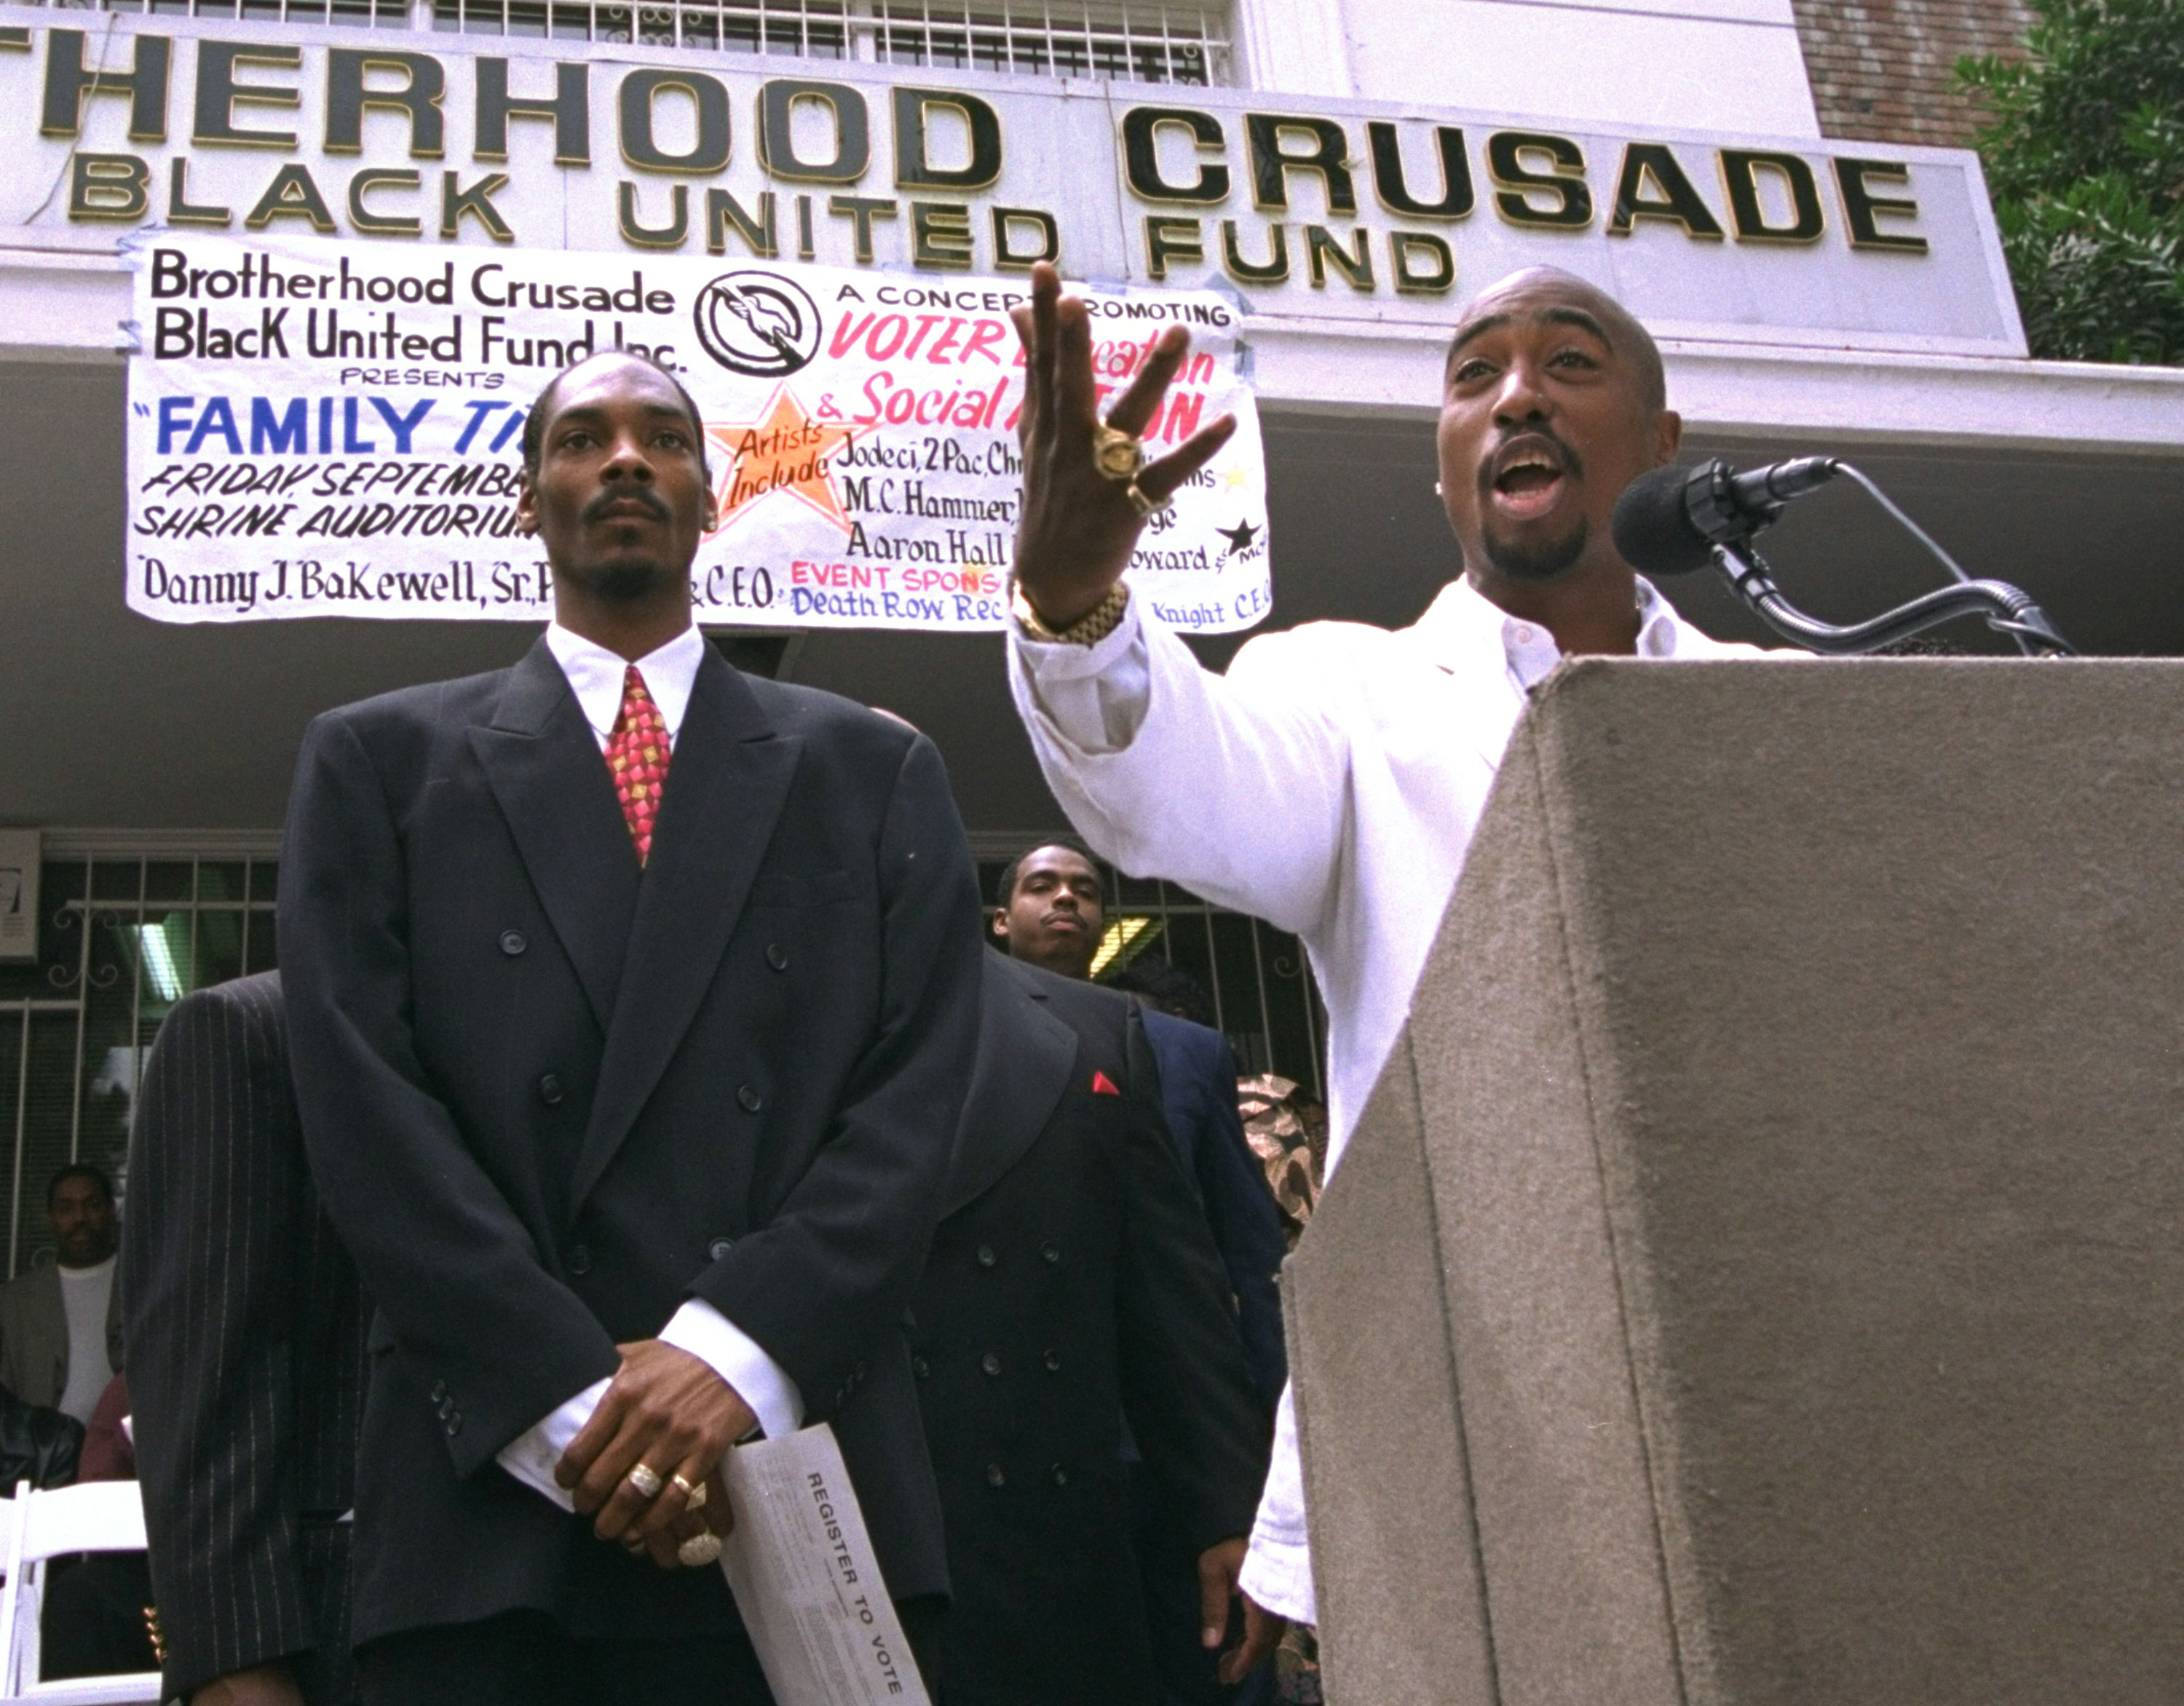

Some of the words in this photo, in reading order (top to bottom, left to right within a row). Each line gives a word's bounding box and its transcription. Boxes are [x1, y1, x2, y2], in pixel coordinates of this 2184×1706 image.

[1120, 106, 1929, 254] CRUSADE
[68, 151, 515, 241] BLACK
[617, 180, 1060, 269] UNITED
[1141, 215, 1456, 292] FUND
[151, 248, 454, 305] Brotherhood
[470, 263, 676, 314] Crusade
[836, 284, 866, 303] A
[876, 286, 1034, 312] CONCEP
[1081, 298, 1231, 328] ROMOTING
[306, 307, 462, 363] United
[481, 314, 594, 368] Fund
[827, 309, 1008, 366] VOTER
[340, 367, 505, 389] PRESENTS
[816, 392, 843, 421] &
[852, 370, 1010, 429] Social
[734, 417, 823, 461] Artists
[312, 461, 521, 498] SEPTEMBE
[727, 451, 829, 509] Include
[133, 503, 298, 540] SHRINE
[296, 502, 532, 540] AUDITORIU
[846, 520, 945, 563] Aaron
[946, 528, 1008, 566] Hall
[1130, 544, 1211, 571] oward
[137, 554, 260, 614] Danny
[791, 560, 890, 590] EVENT
[790, 586, 879, 617] Death
[881, 591, 944, 622] Row
[1150, 601, 1226, 630] Knight
[807, 1471, 858, 1585] REGISTER
[853, 1594, 874, 1625] TO
[871, 1635, 903, 1696] VOTE
